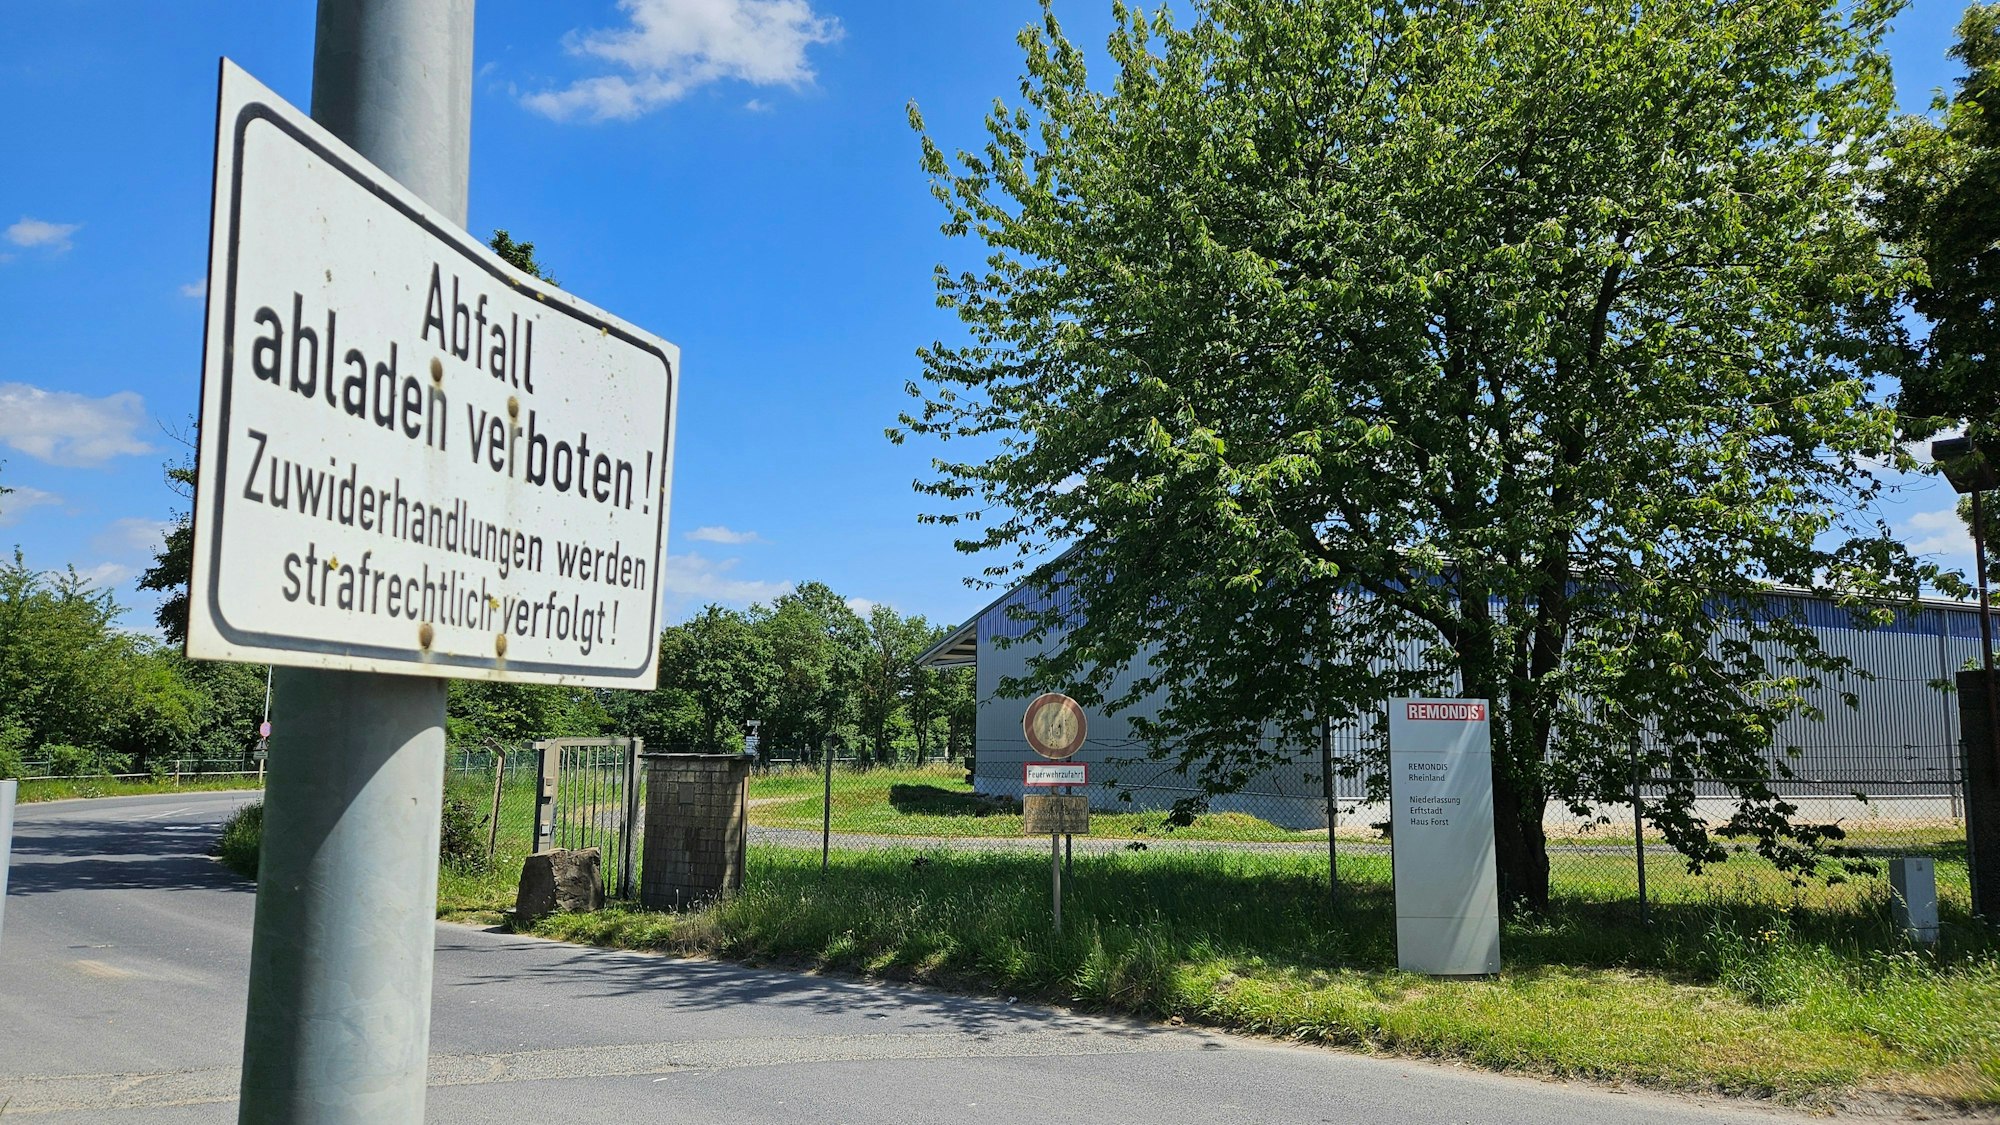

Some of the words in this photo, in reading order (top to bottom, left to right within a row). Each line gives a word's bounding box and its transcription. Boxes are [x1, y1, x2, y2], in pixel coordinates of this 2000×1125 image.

[421, 261, 533, 394] Abfall
[252, 291, 447, 451] abladen
[243, 428, 542, 580] Zuwiderhandlungen
[557, 541, 645, 590] werden
[282, 542, 492, 631] strafrechtlich
[503, 591, 618, 656] verfolgt!
[1408, 763, 1448, 771] REMONDIS
[1028, 770, 1083, 778] Feuerwehrzufahrt
[1409, 796, 1461, 805] Niederlassung
[1410, 807, 1443, 815] Erftstadt
[1410, 818, 1429, 826] Haus
[1430, 818, 1449, 826] Forst
